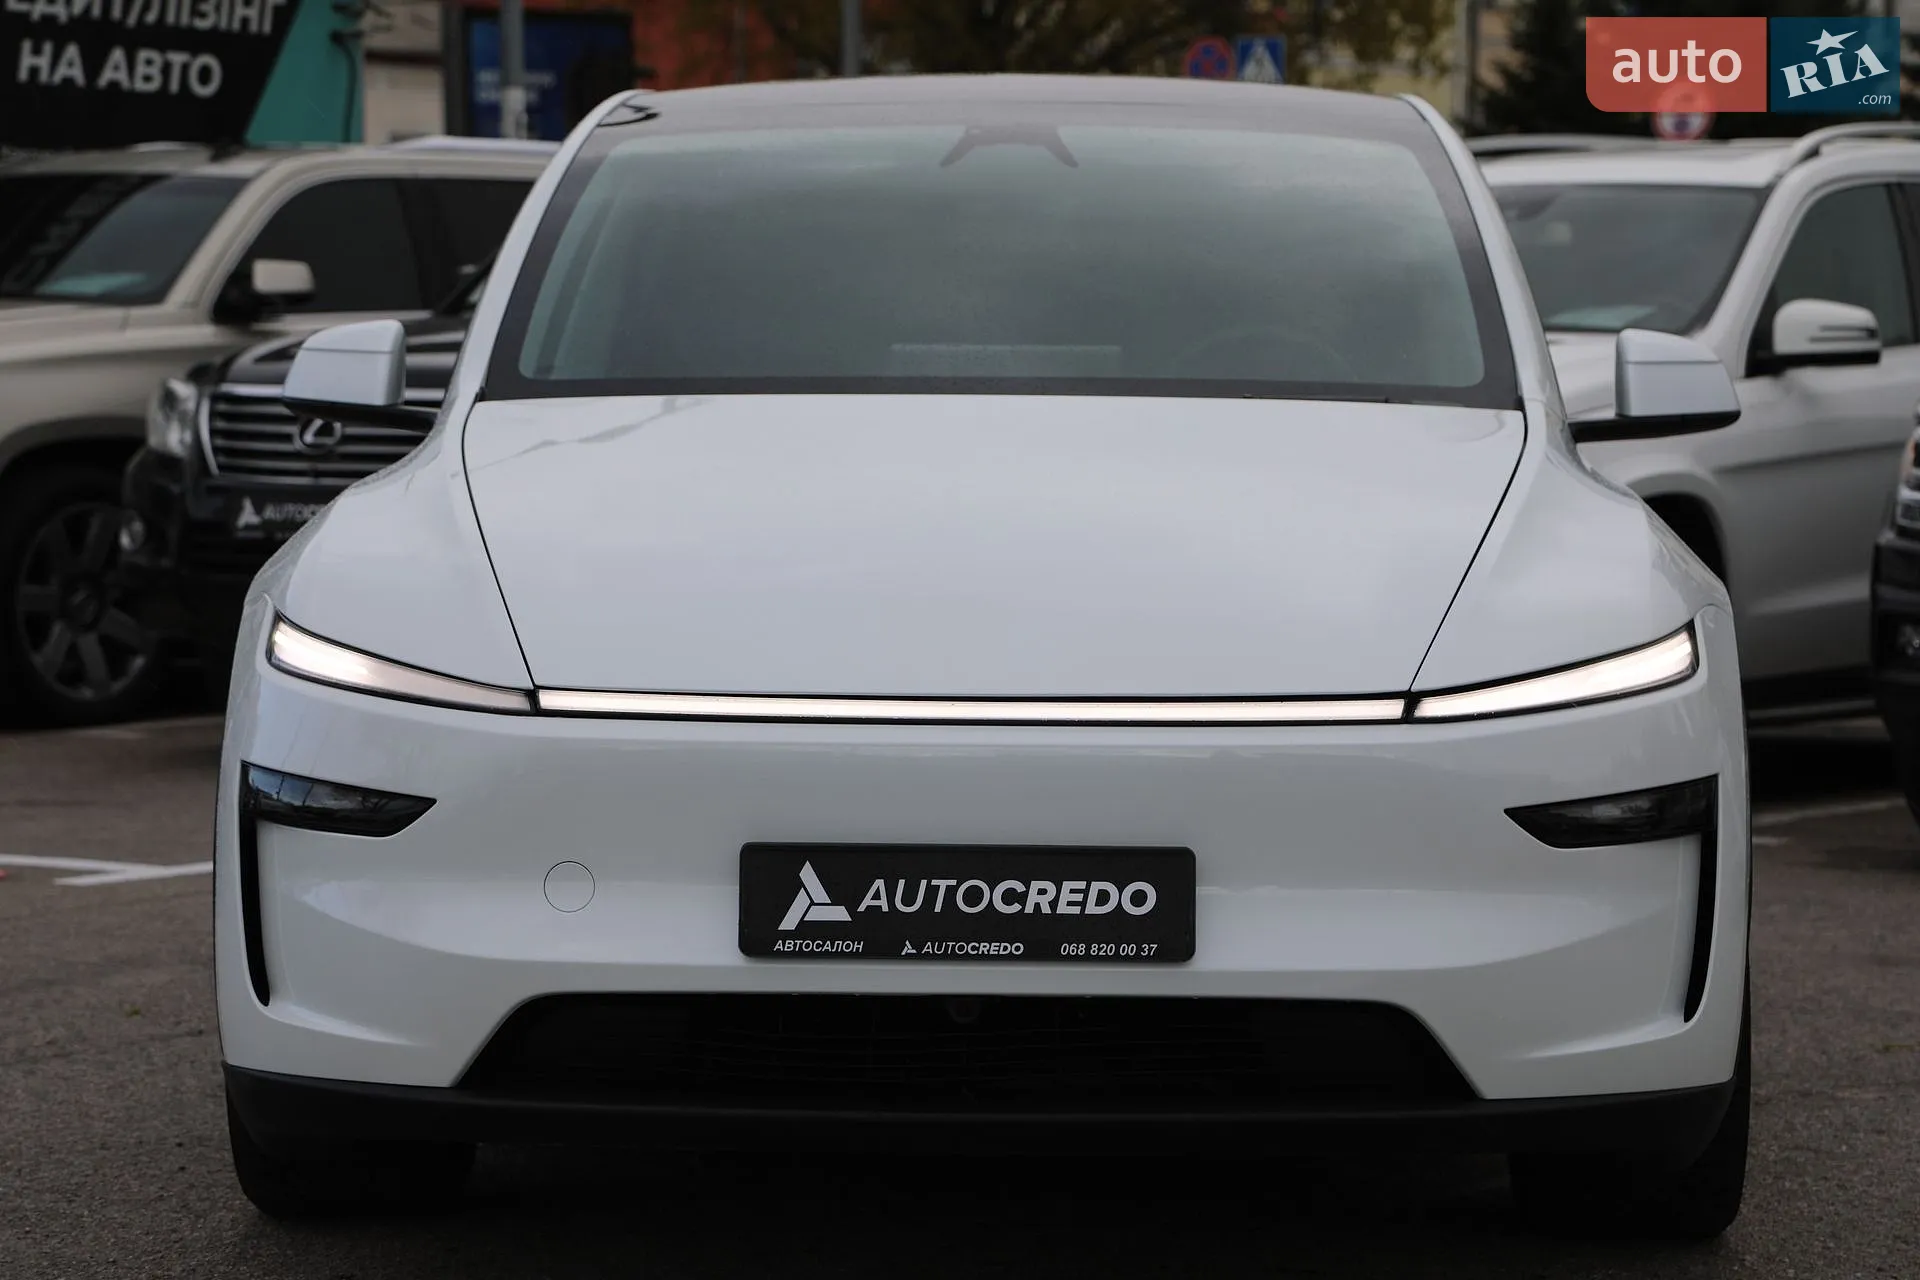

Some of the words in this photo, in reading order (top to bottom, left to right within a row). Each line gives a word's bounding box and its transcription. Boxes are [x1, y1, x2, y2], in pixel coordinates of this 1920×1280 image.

[17, 39, 86, 87] НА
[97, 46, 223, 98] АВТО
[857, 878, 1157, 916] AUTOCREDO
[773, 939, 864, 953] АВТОСАЛОН
[921, 941, 1024, 955] AUTOCREDO
[1060, 943, 1086, 956] 068
[1090, 943, 1116, 956] 820
[1119, 943, 1137, 956] 00
[1140, 943, 1158, 956] 37
